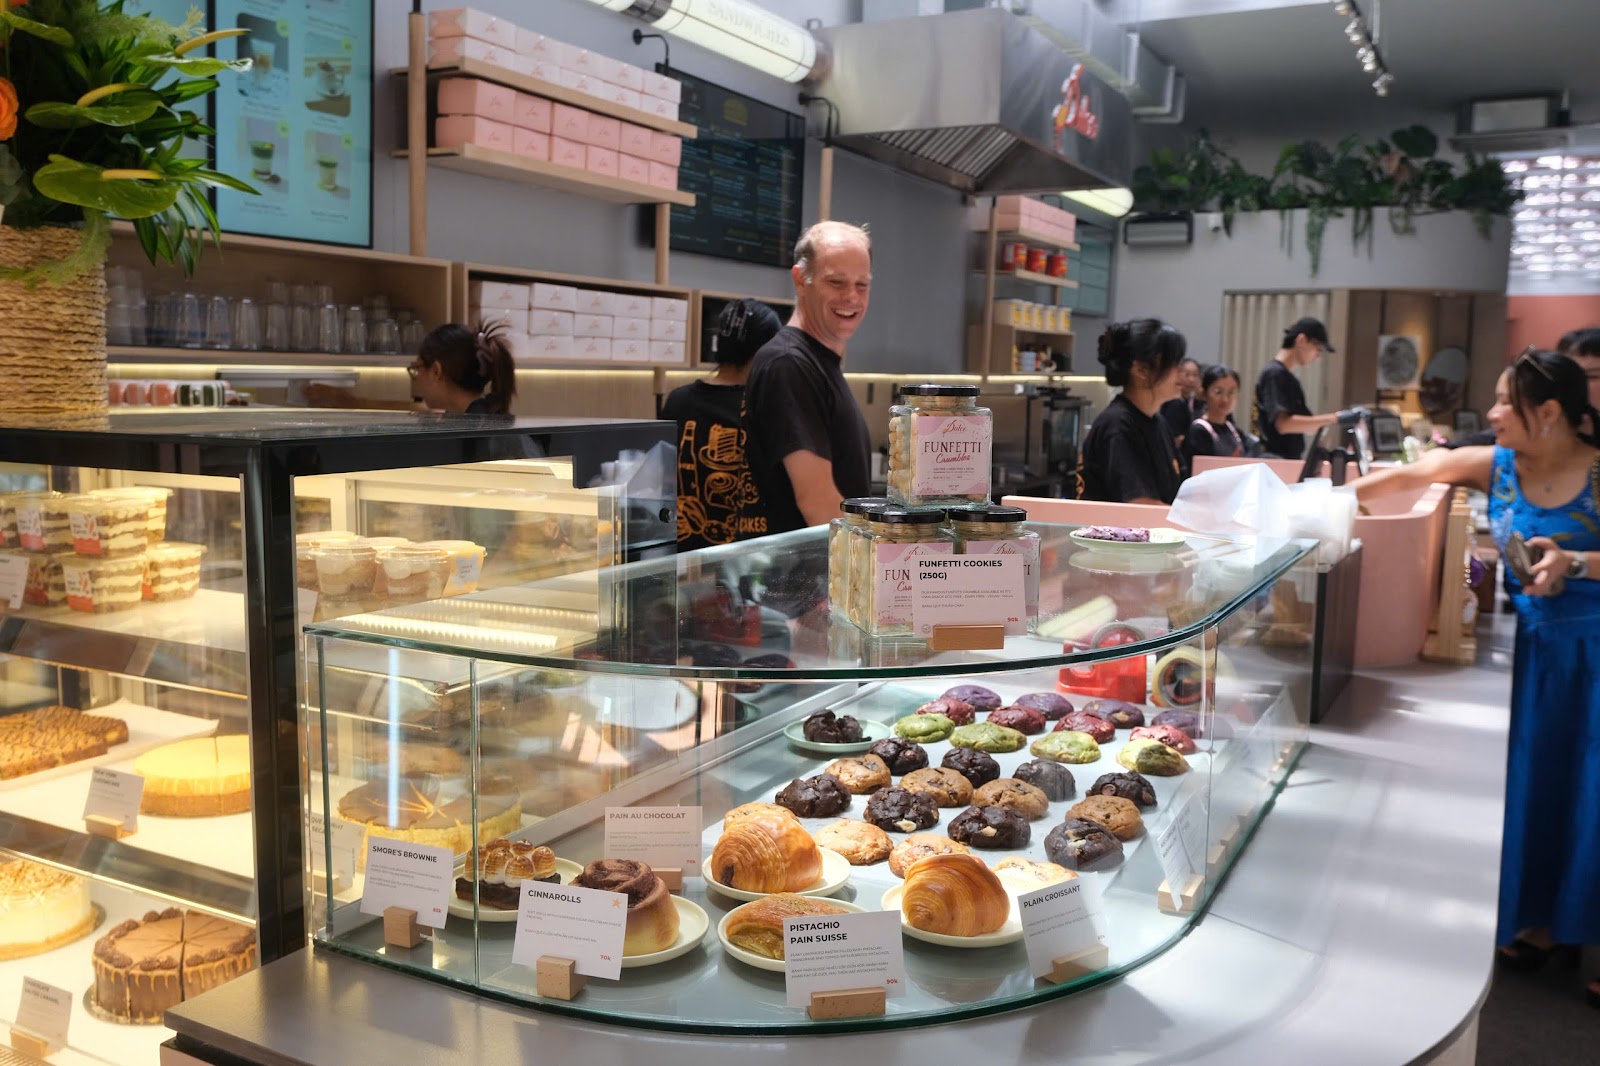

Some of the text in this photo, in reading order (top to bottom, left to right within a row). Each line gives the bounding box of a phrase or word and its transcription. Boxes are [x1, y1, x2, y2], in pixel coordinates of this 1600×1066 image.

[924, 441, 982, 453] FUNFETTI
[935, 452, 971, 464] Crumbles
[919, 572, 947, 580] (250G)
[372, 846, 437, 862] SMORE'S BROWNIE
[528, 890, 582, 904] CINNAROLLS
[1024, 885, 1080, 908] PLAIN CROISSANT
[790, 922, 840, 932] PISTACHIO
[790, 933, 848, 944] PAIN SUISSE
